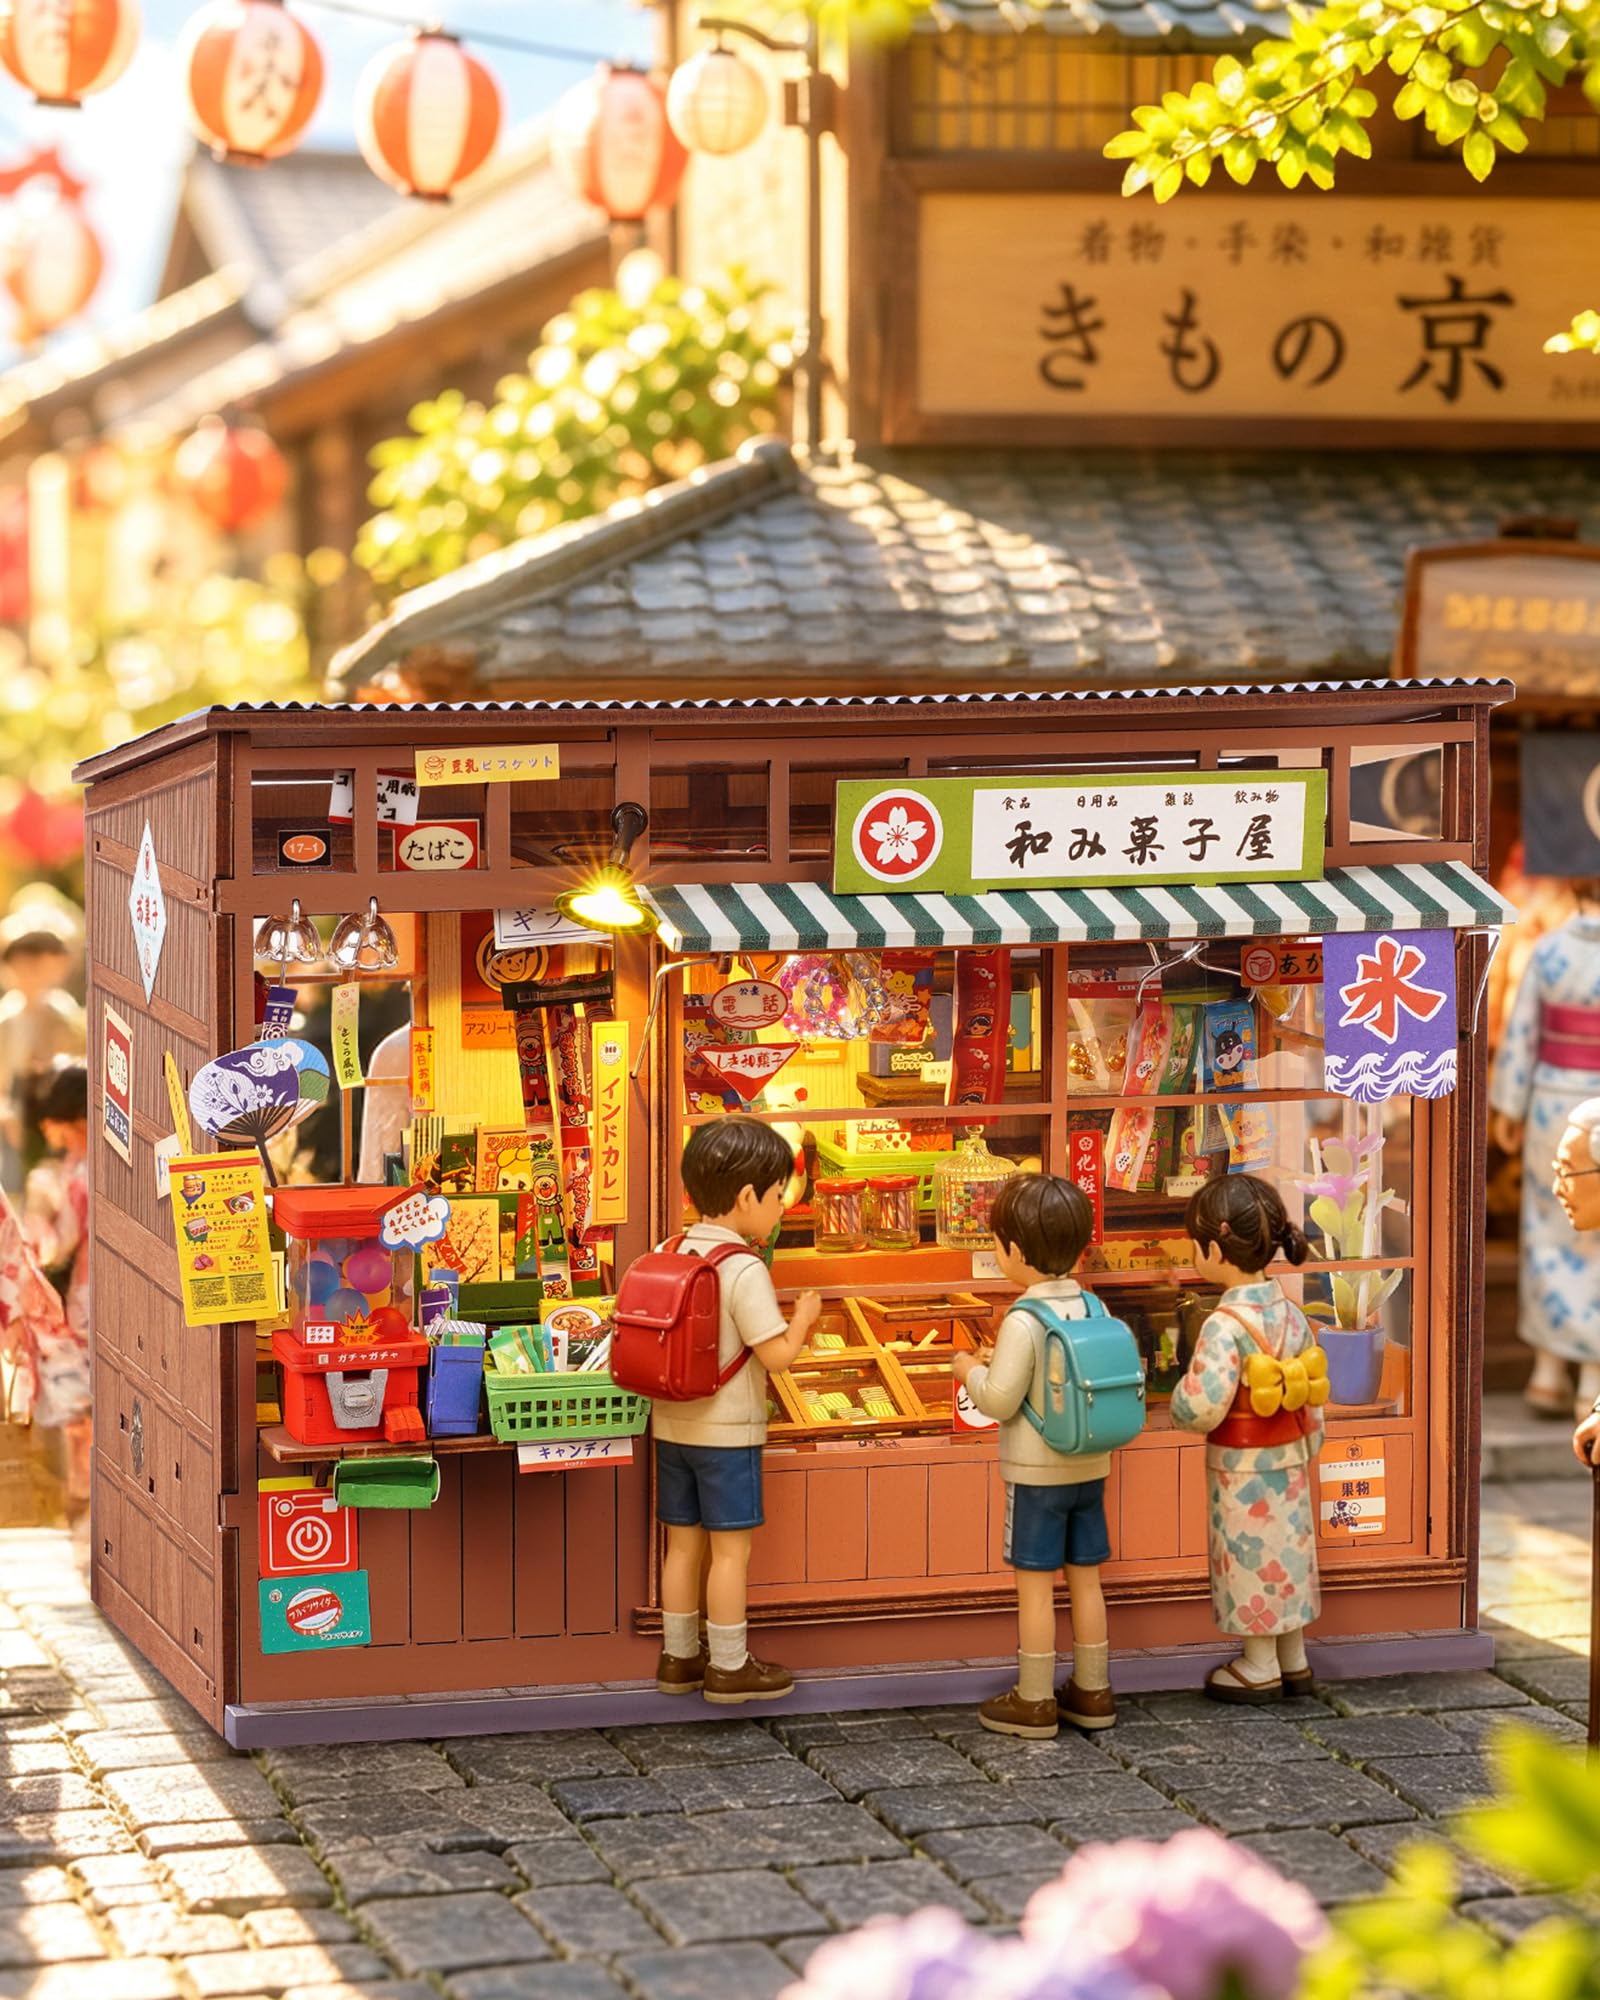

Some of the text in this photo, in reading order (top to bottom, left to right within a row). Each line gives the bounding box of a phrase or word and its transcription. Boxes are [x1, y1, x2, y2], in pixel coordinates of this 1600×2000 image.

[1077, 219, 1506, 267] 着物・手染・和雑貨
[1037, 273, 1517, 405] きもの京
[452, 755, 553, 775] 豆乳ビスケット
[1002, 795, 1031, 811] 食品
[1076, 794, 1119, 808] 日用品
[1234, 789, 1280, 804] 飲み物
[288, 842, 319, 854] 17-1
[406, 839, 466, 861] たばこ
[1004, 813, 1275, 869] 和み菓子屋
[1340, 935, 1447, 1043] 氷
[721, 994, 779, 1015] 電話
[337, 1351, 399, 1364] ガチャガチャ
[538, 1441, 611, 1460] キャンディ
[1341, 1481, 1370, 1497] 果物
